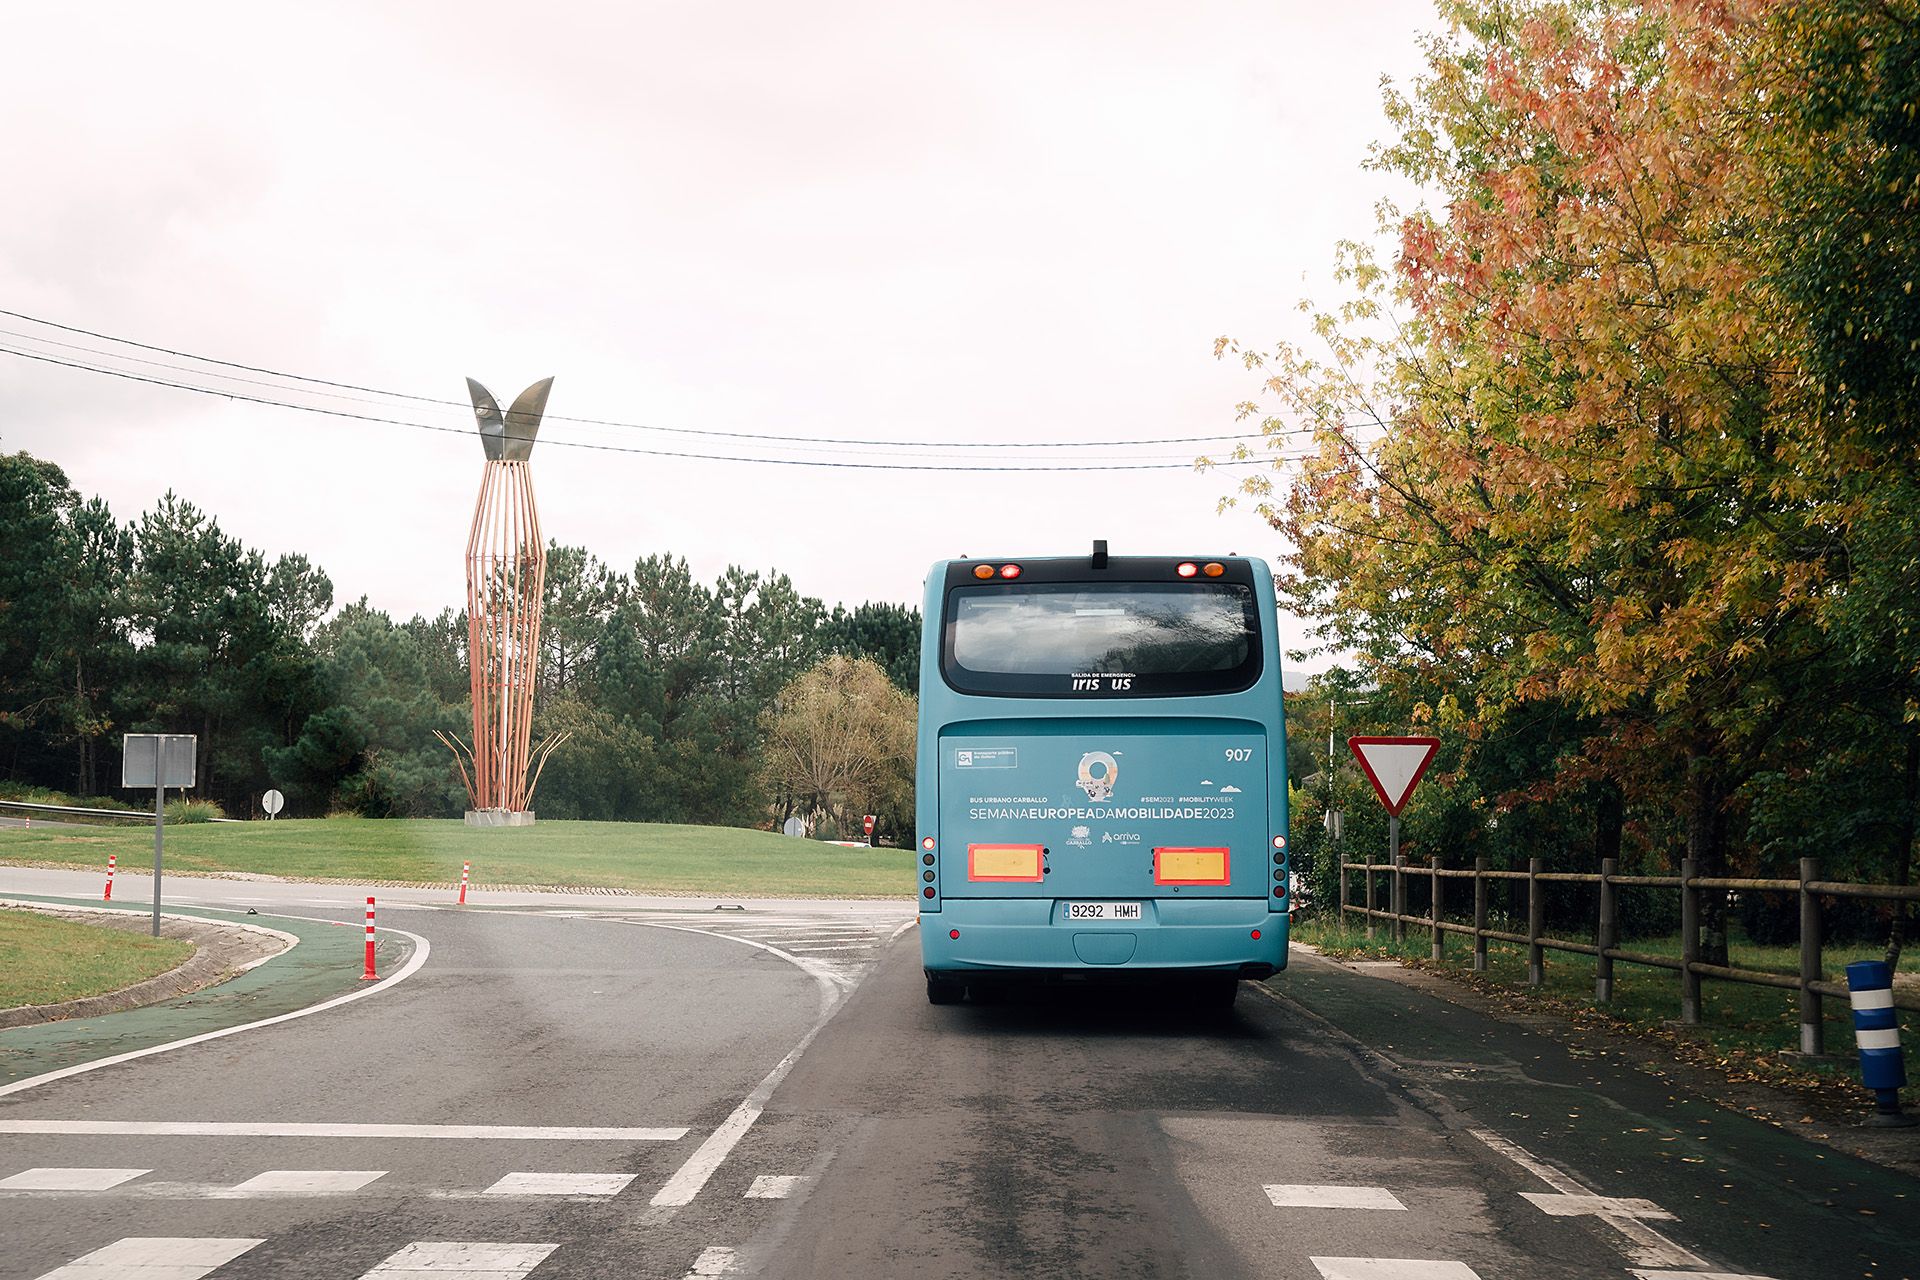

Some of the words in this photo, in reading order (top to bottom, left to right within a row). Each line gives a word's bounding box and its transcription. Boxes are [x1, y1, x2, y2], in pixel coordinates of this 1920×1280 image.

[1225, 749, 1252, 762] 907
[969, 808, 1235, 820] SEMANAEUROPEADAMOBILIDADE2023
[1113, 832, 1140, 841] arriva
[1072, 905, 1104, 918] 9292
[1114, 905, 1138, 918] HMH
